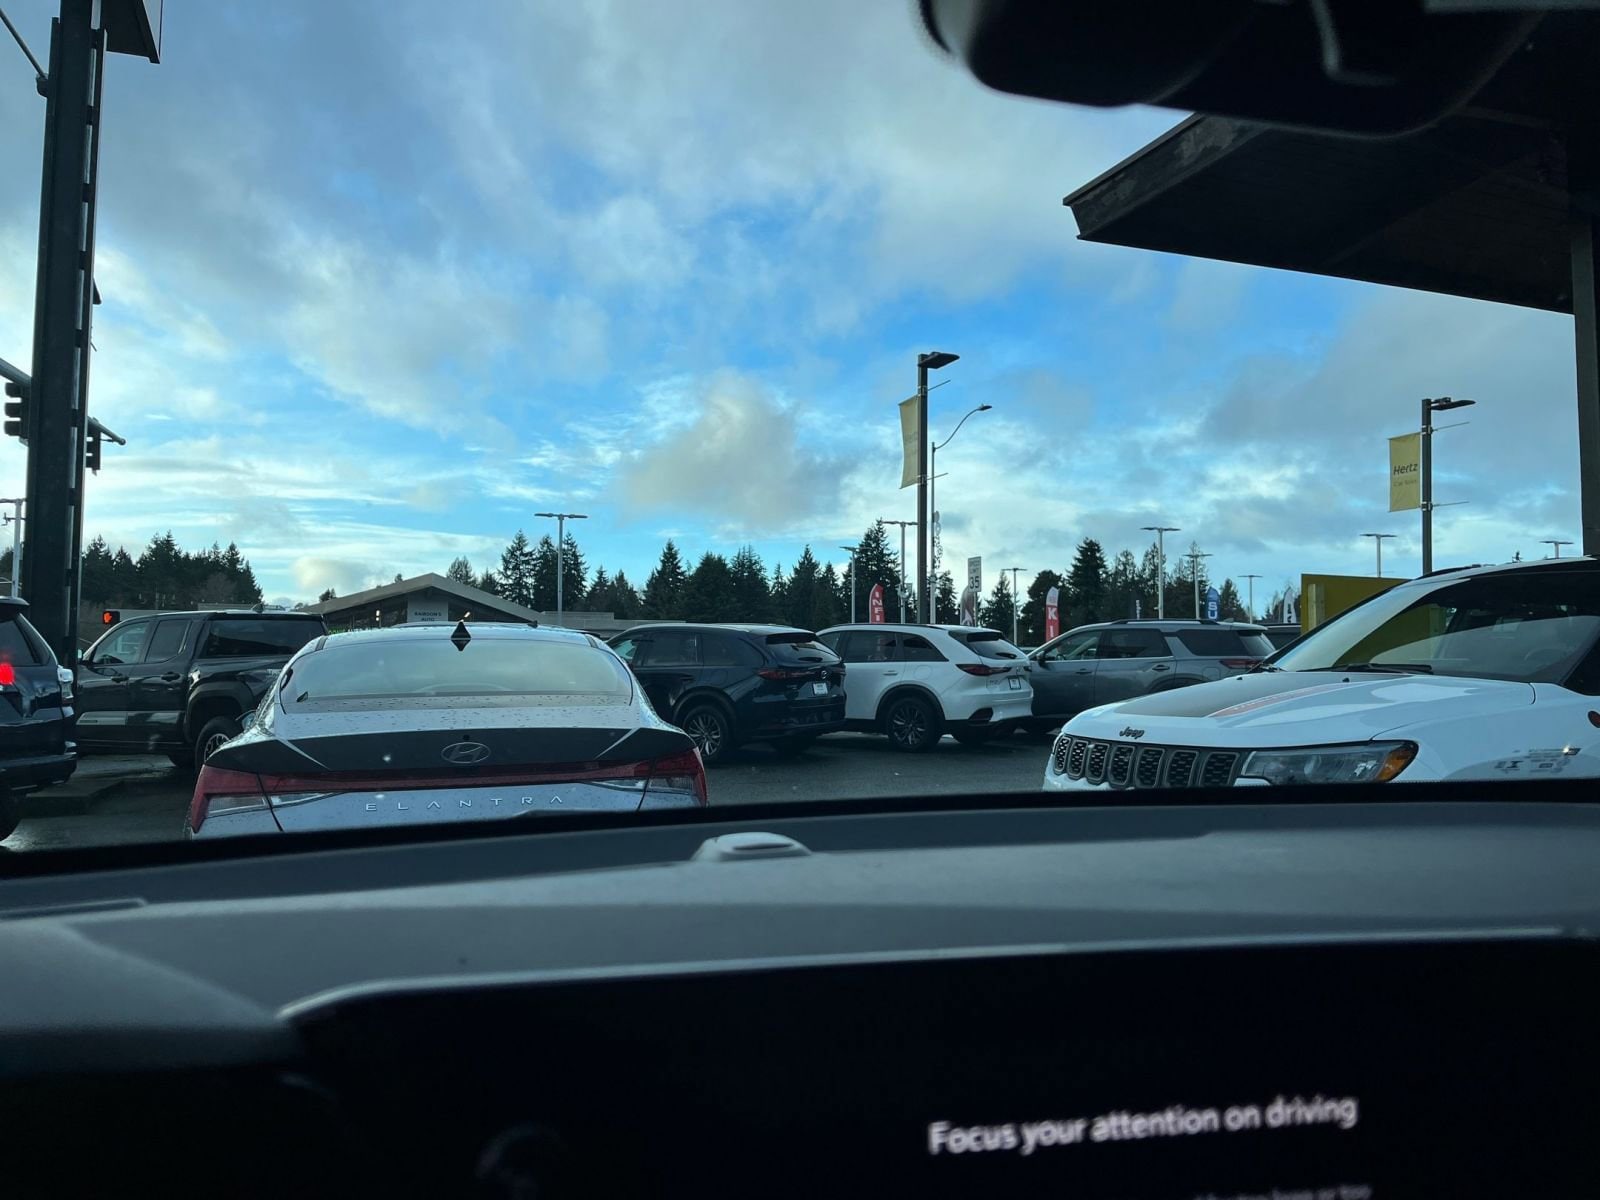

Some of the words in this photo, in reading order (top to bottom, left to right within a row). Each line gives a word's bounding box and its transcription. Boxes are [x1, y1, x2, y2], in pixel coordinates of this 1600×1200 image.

[1393, 463, 1418, 476] Hertz
[969, 575, 980, 589] 35
[1119, 726, 1145, 740] Jeep
[365, 795, 563, 811] ELANTRA
[929, 1121, 1018, 1154] Focus
[1021, 1119, 1087, 1155] your
[1091, 1106, 1220, 1142] attention
[1224, 1106, 1261, 1130] on
[1265, 1096, 1357, 1128] driving
